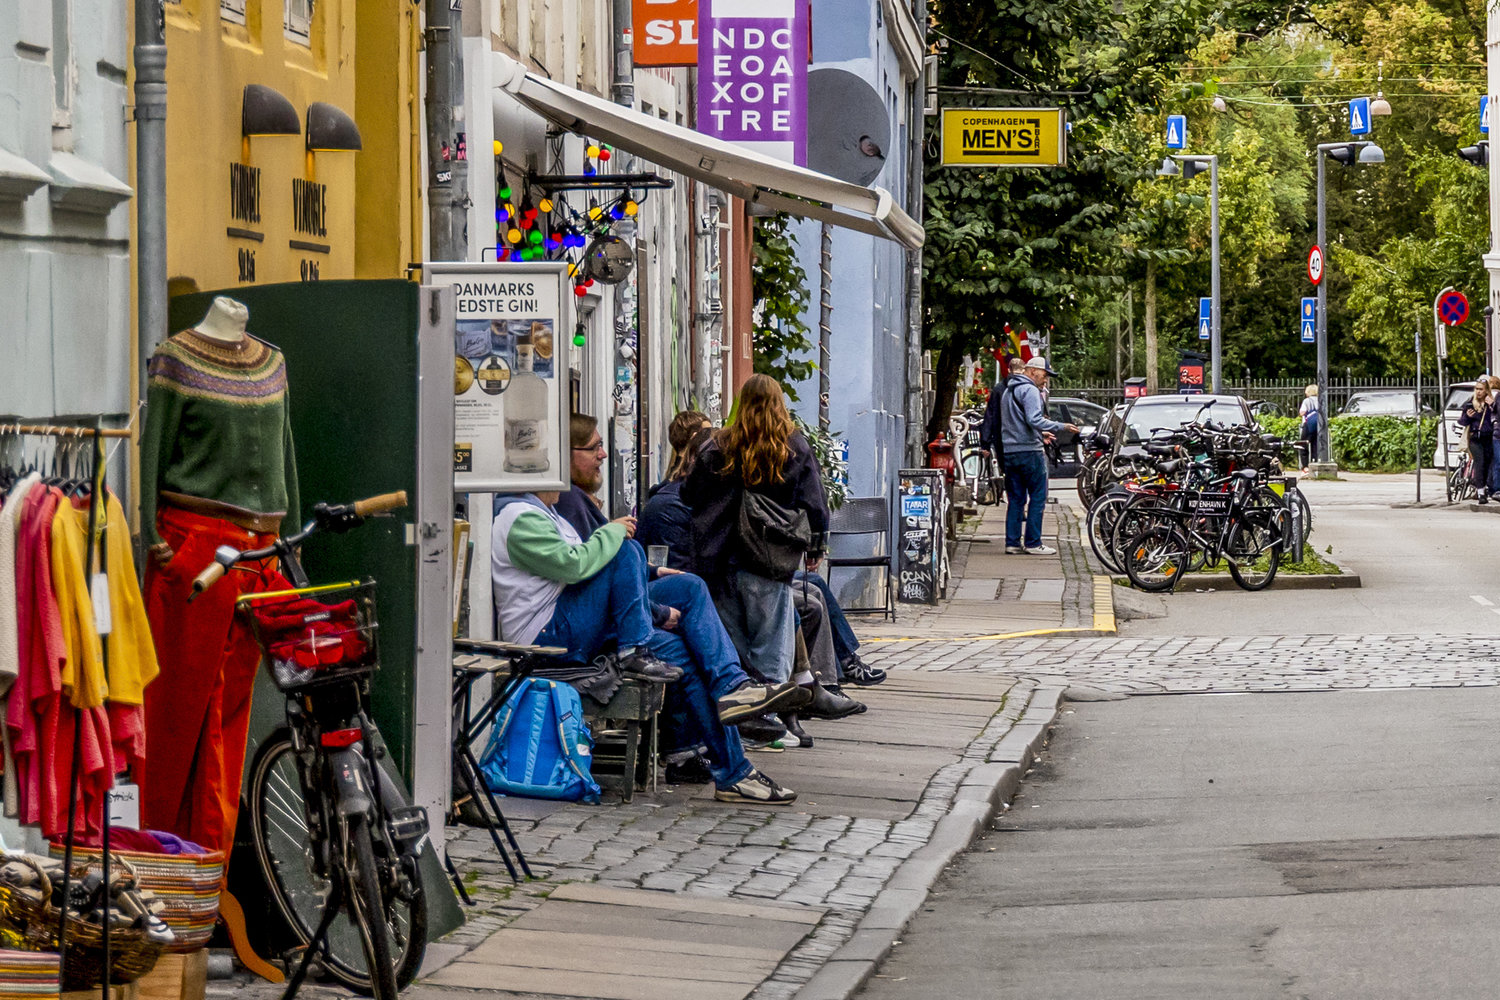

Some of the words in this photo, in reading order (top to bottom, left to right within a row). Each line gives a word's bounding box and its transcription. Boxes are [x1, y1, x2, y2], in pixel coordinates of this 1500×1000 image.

[962, 118, 1025, 126] COPENHAGEN
[230, 161, 261, 224] VINOBLE
[292, 177, 327, 238] VINOBLE
[1311, 257, 1320, 272] 40
[454, 283, 535, 296] DANMARKS
[456, 299, 505, 313] EDSTE
[508, 299, 538, 313] GIN!
